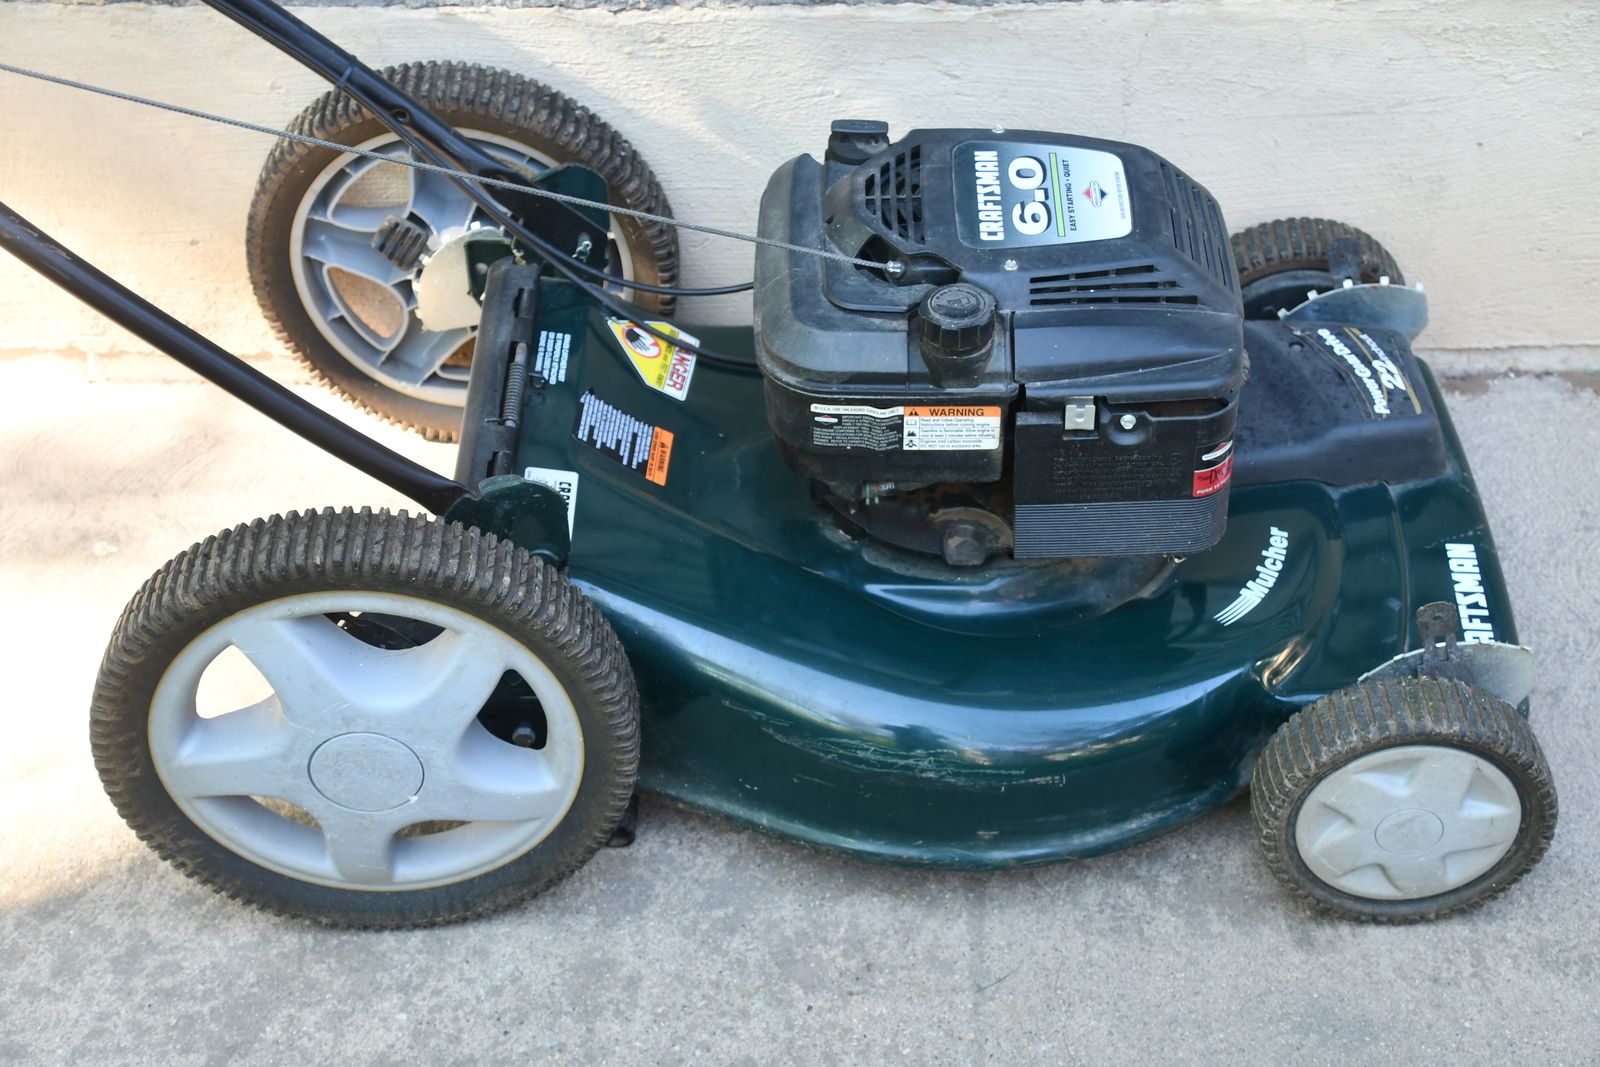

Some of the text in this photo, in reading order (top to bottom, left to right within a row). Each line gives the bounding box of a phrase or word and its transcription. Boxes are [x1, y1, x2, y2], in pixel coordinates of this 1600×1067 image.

[974, 151, 1005, 241] CRAFTSMAN
[1008, 155, 1051, 235] 6.0
[1062, 159, 1077, 231] EASY STARTING QUIET
[667, 339, 691, 393] ANGER
[929, 408, 985, 417] WARNING
[1240, 526, 1289, 602] Mulcher
[1445, 543, 1495, 643] AFTSMAN
